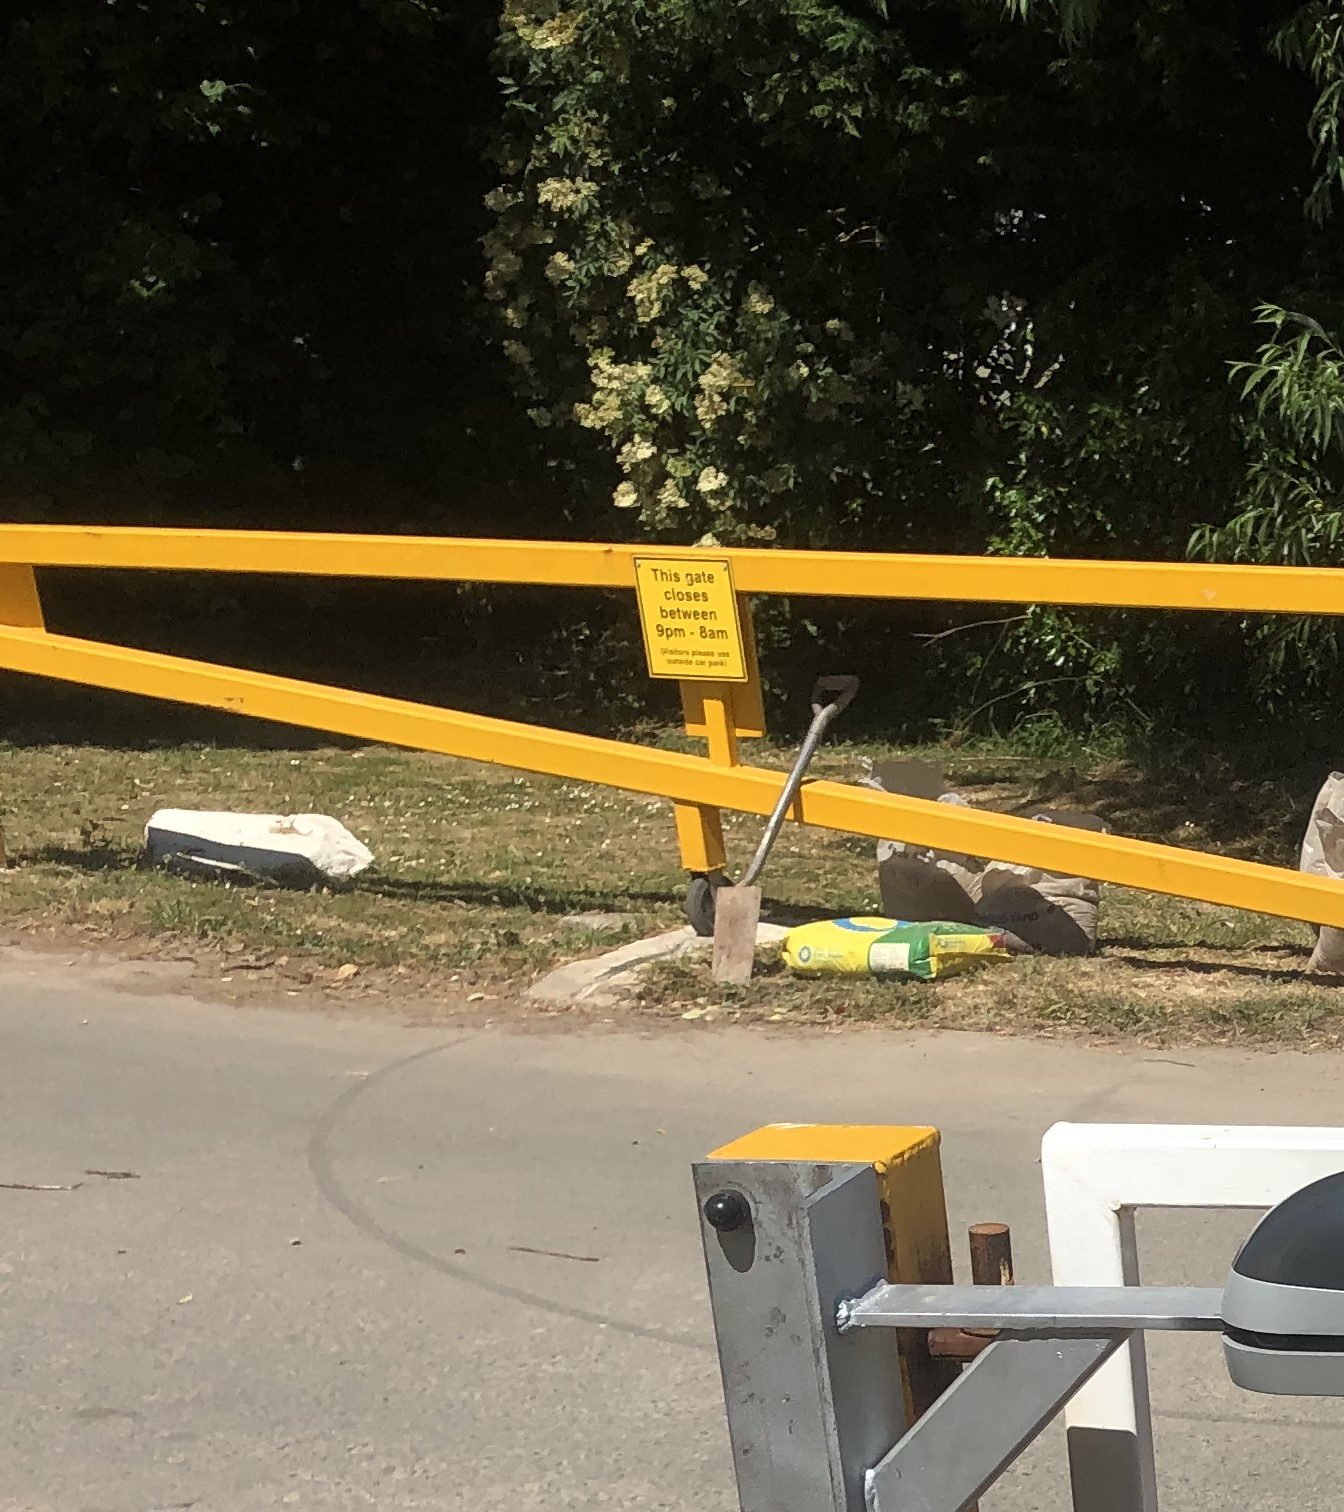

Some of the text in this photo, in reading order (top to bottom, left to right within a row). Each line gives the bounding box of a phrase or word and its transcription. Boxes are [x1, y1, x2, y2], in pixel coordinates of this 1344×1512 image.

[651, 568, 715, 587] This gate
[664, 588, 709, 602] closes
[660, 606, 717, 621] between
[656, 624, 686, 640] 9pm
[699, 625, 728, 640] 8am
